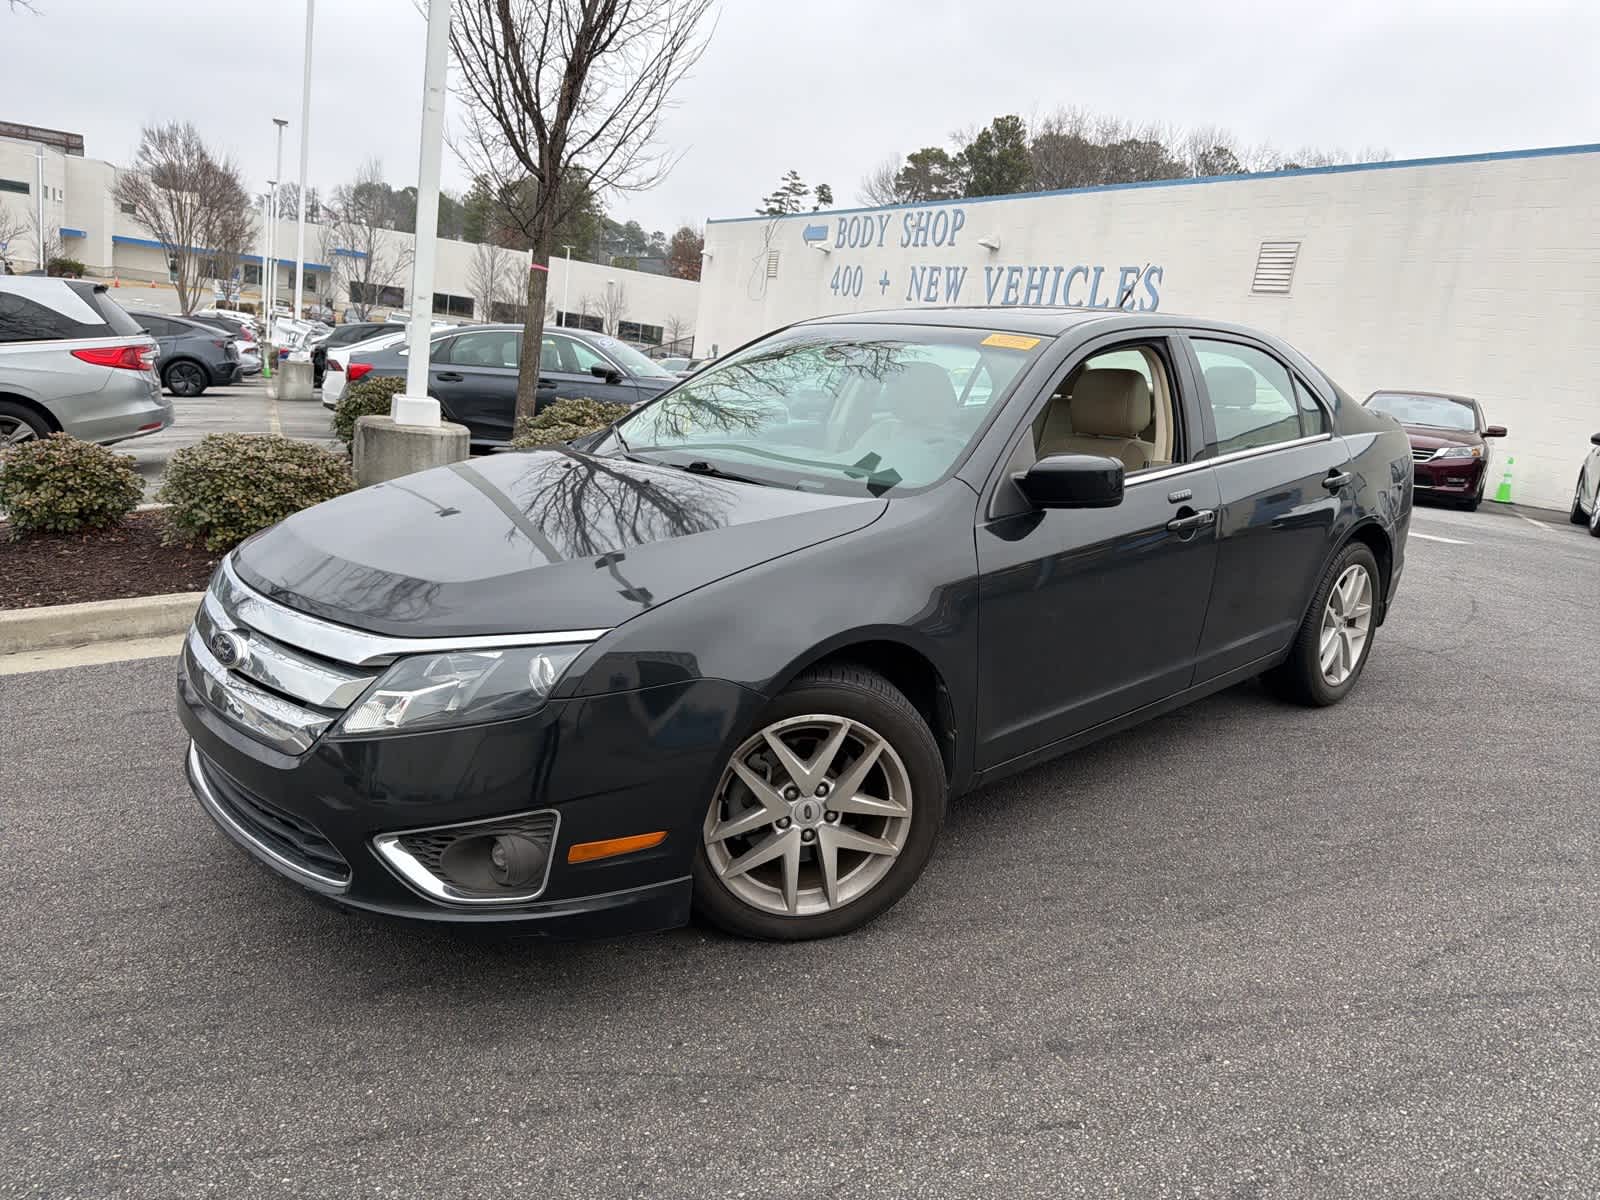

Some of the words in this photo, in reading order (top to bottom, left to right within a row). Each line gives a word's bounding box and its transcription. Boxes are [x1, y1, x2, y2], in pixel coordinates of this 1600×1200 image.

[834, 214, 891, 248] BODY
[901, 208, 965, 248] SHOP
[830, 265, 863, 297] 400
[879, 269, 890, 295] +
[906, 266, 968, 304] NEW
[984, 265, 1163, 313] VEHICLES
